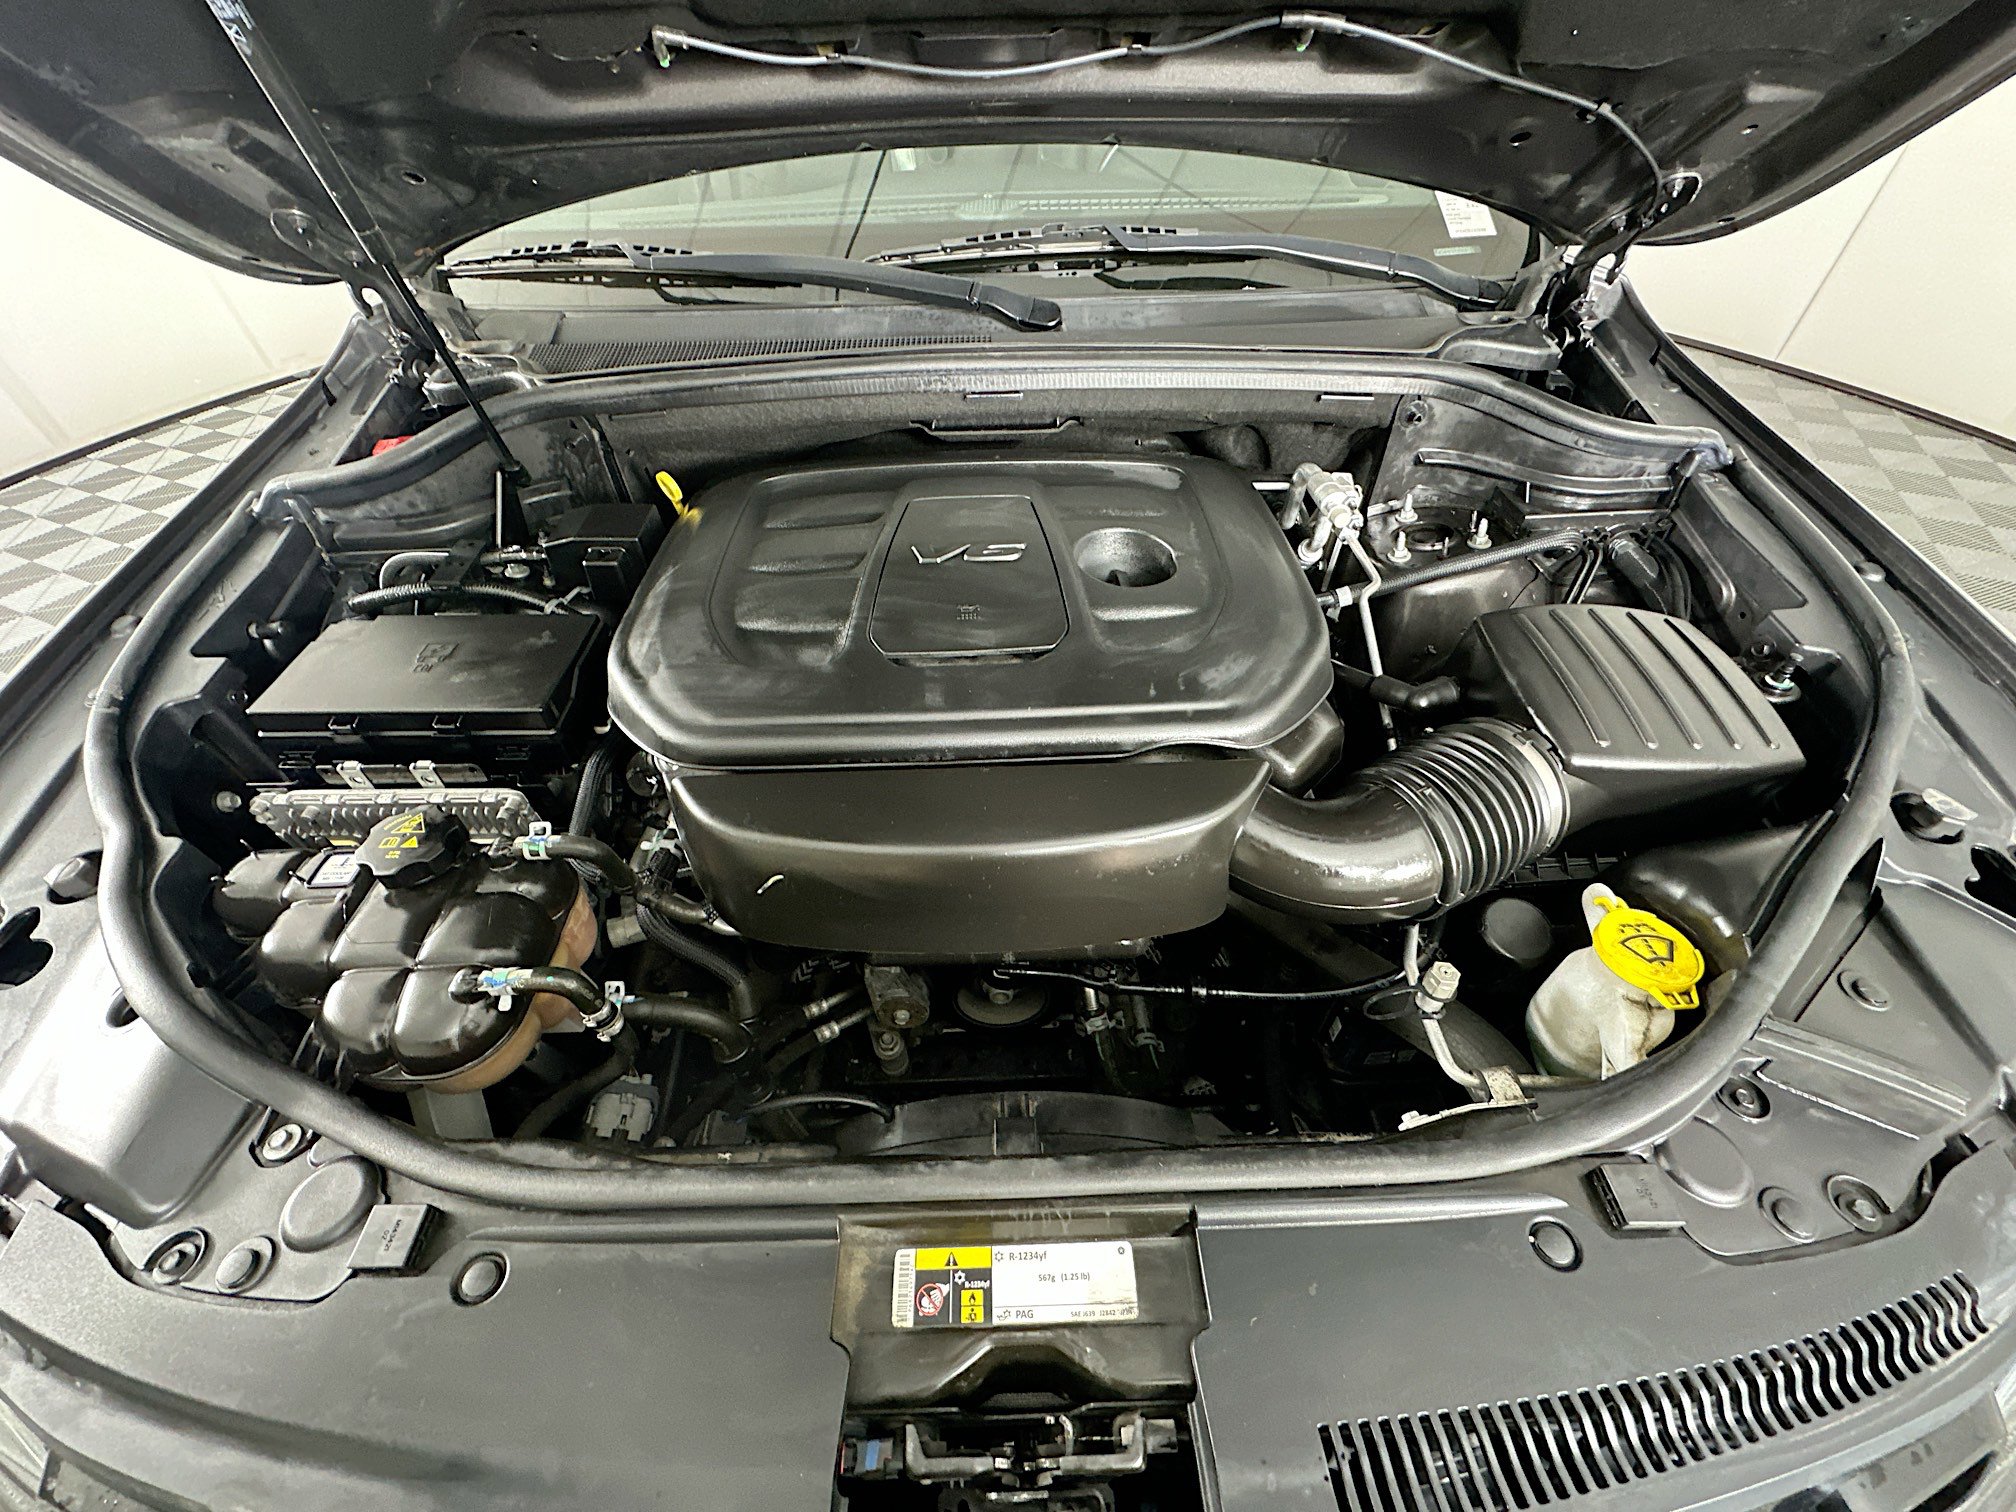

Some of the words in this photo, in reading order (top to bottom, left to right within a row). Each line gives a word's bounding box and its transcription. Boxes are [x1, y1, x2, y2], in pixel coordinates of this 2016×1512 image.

[910, 542, 1027, 564] V6
[1008, 1250, 1047, 1261] R-1234yf
[1038, 1273, 1056, 1283] 567g
[1060, 1272, 1079, 1282] (1.25
[1080, 1271, 1091, 1281] lb)
[1015, 1309, 1034, 1319] PAG
